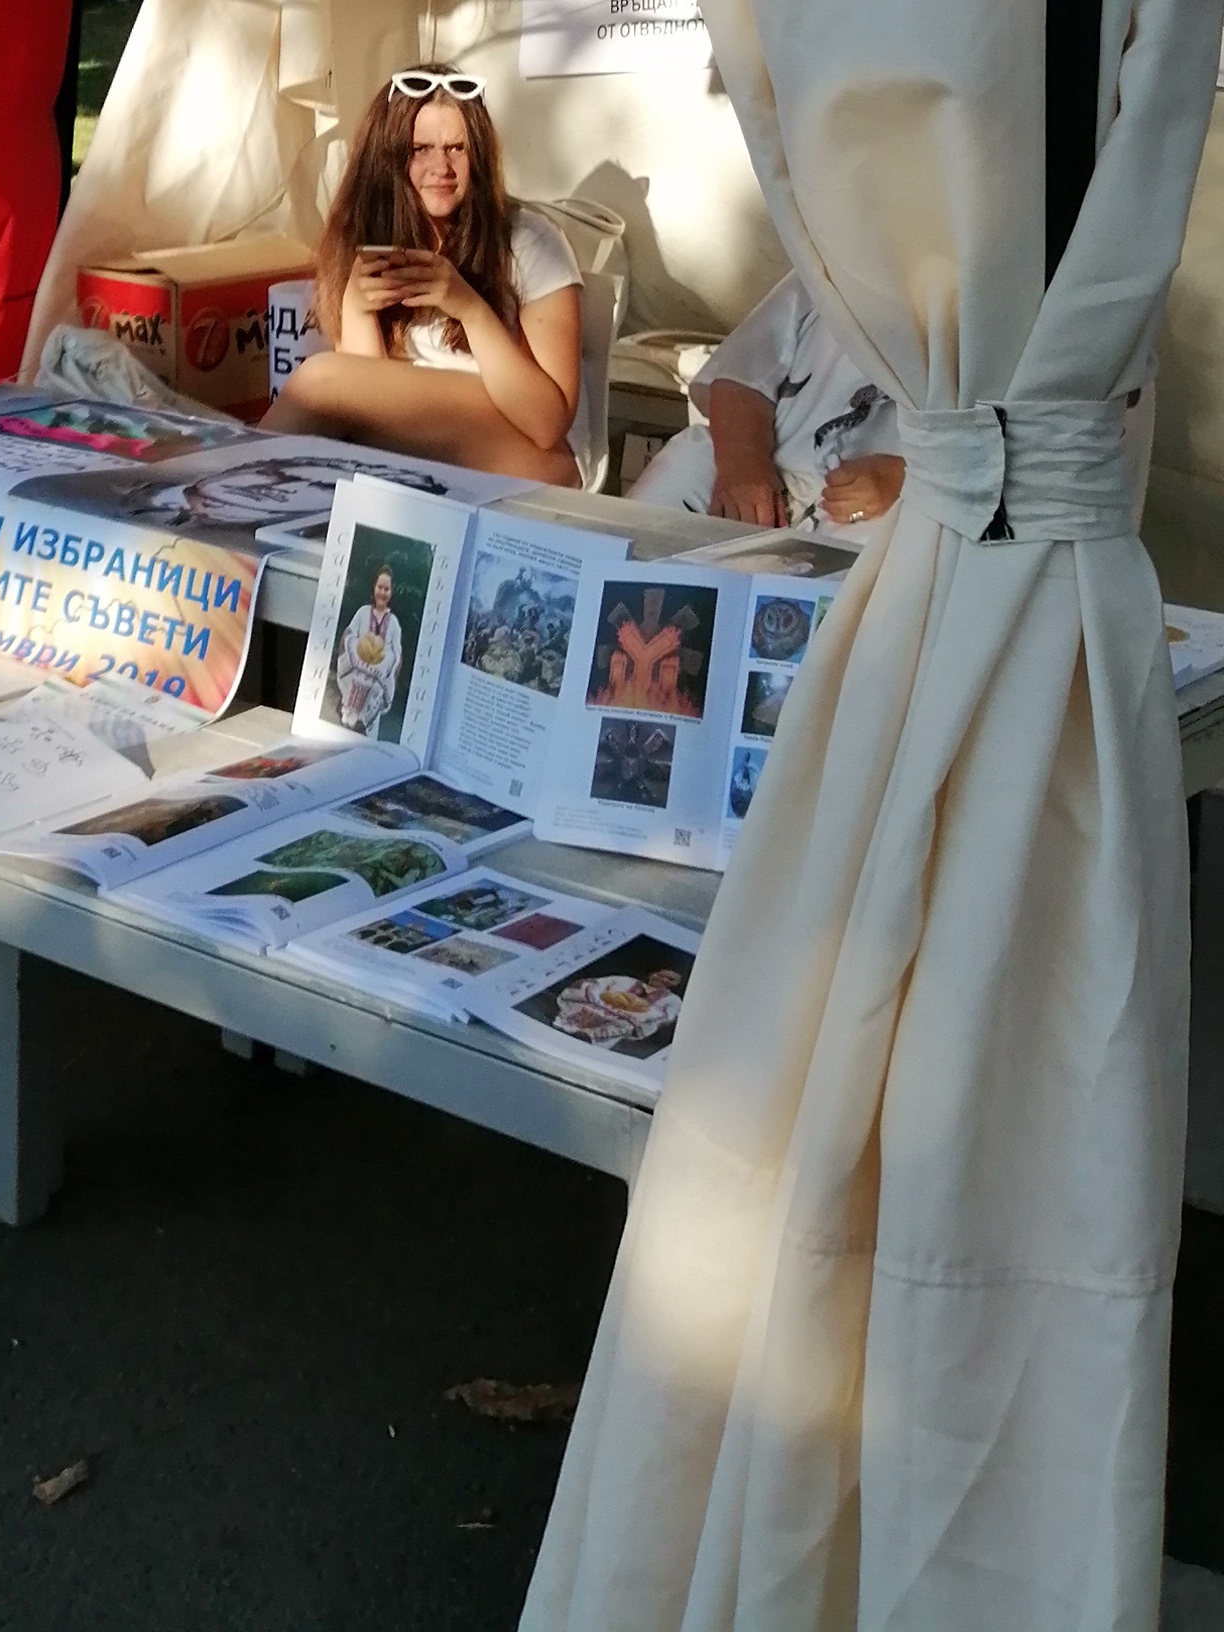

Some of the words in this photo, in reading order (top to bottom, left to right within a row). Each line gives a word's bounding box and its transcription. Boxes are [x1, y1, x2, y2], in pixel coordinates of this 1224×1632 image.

[597, 23, 616, 40] ОТ
[274, 347, 306, 374] Б
[13, 521, 242, 614] ИЗБРАНИЦИ
[63, 588, 211, 661] СЪВЕТИ
